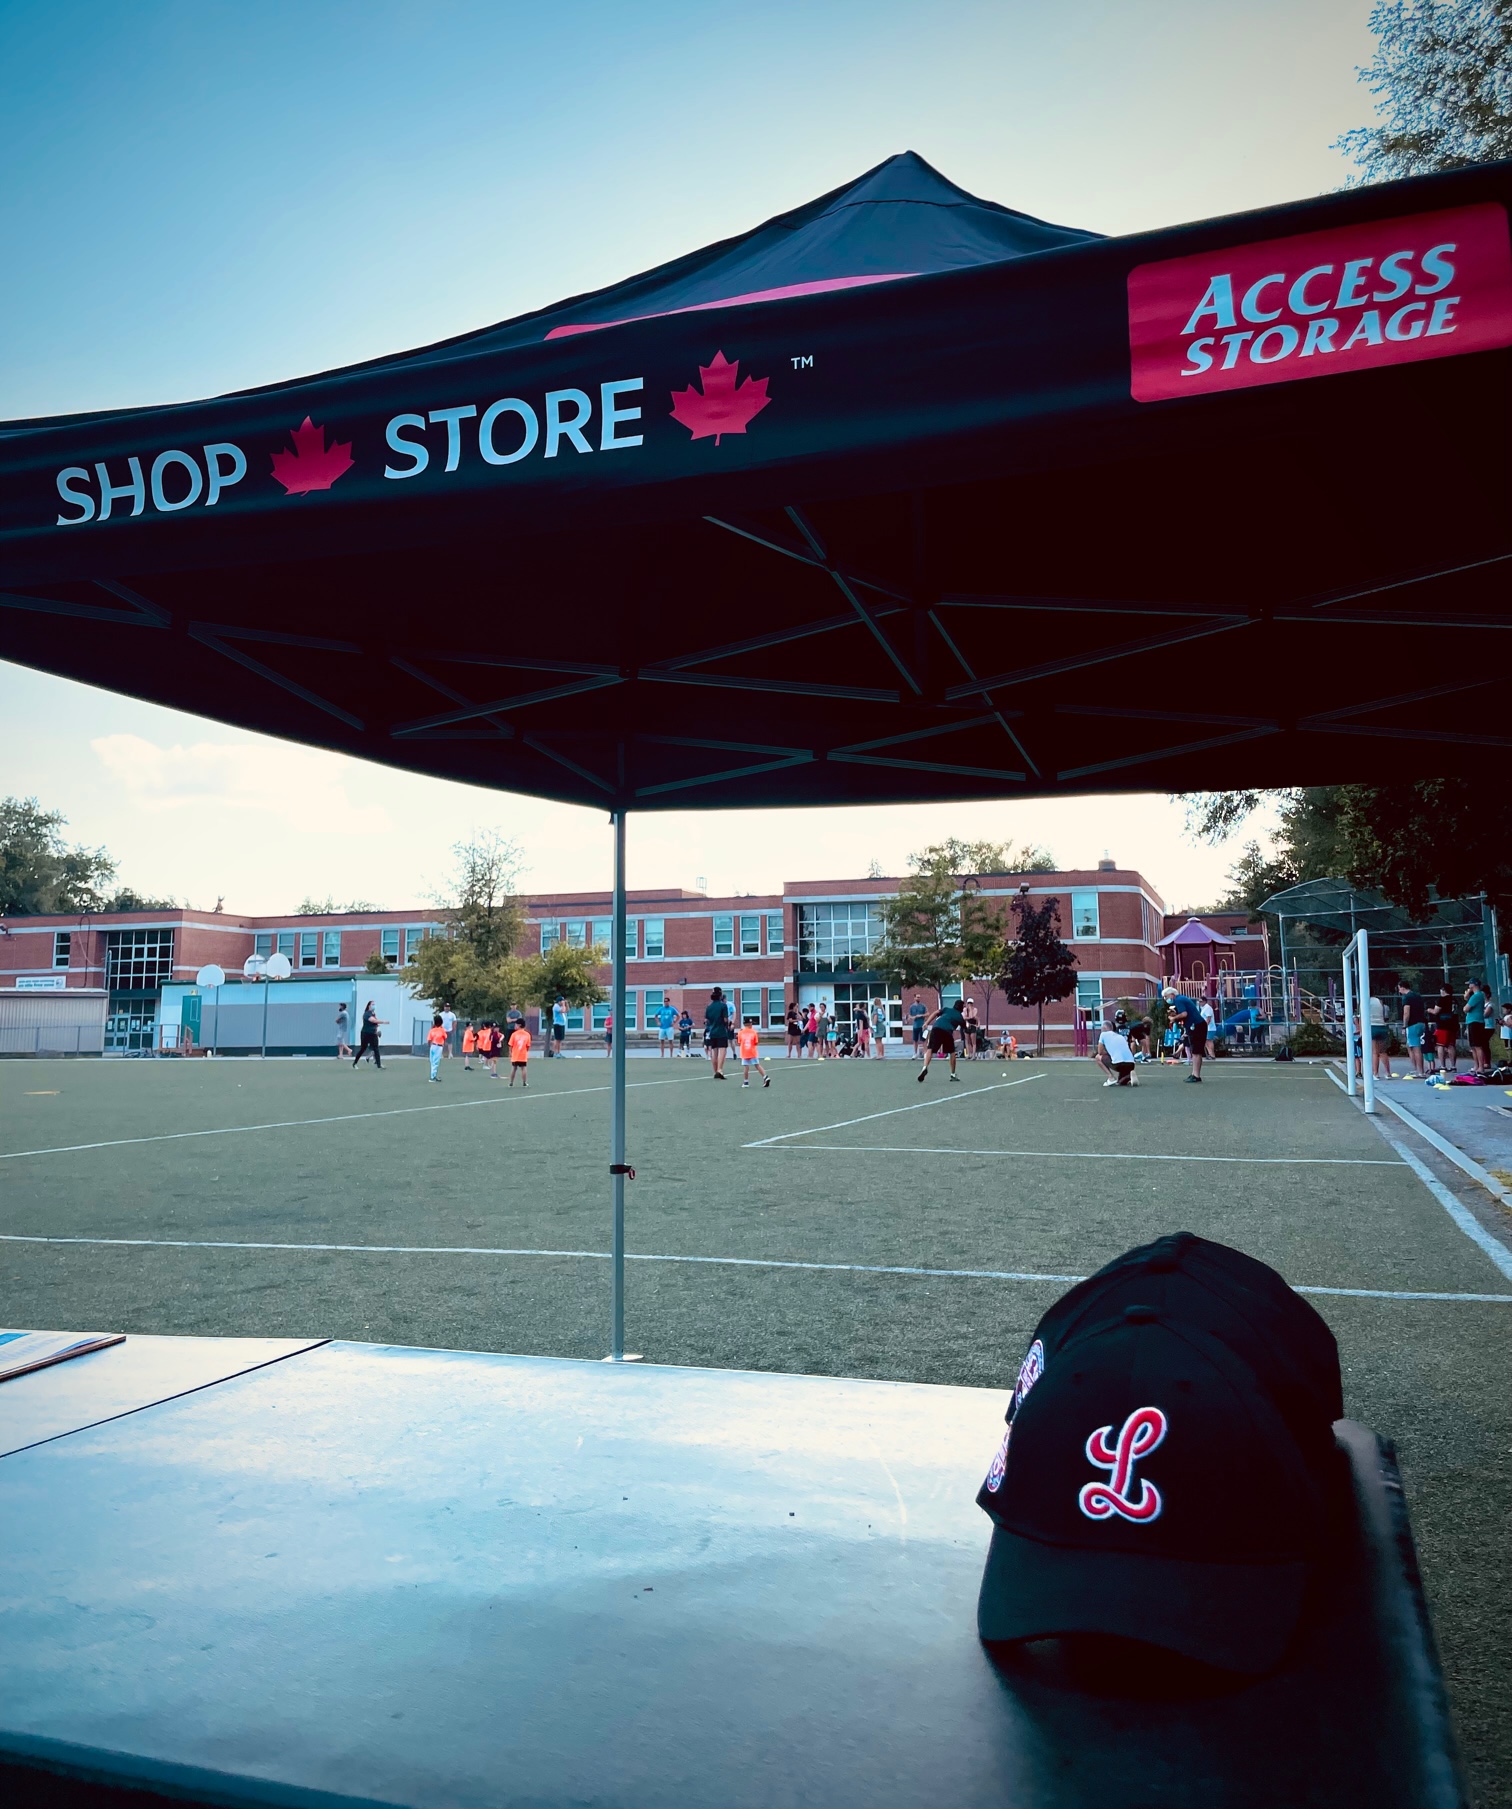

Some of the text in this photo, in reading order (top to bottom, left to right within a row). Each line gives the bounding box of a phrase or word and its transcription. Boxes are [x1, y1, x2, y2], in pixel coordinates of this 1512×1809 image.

[1180, 242, 1458, 335] ACCESS
[1180, 295, 1460, 377] STORAGE
[55, 442, 248, 527] SHOP
[383, 376, 645, 481] STORE
[1078, 1406, 1169, 1523] L
